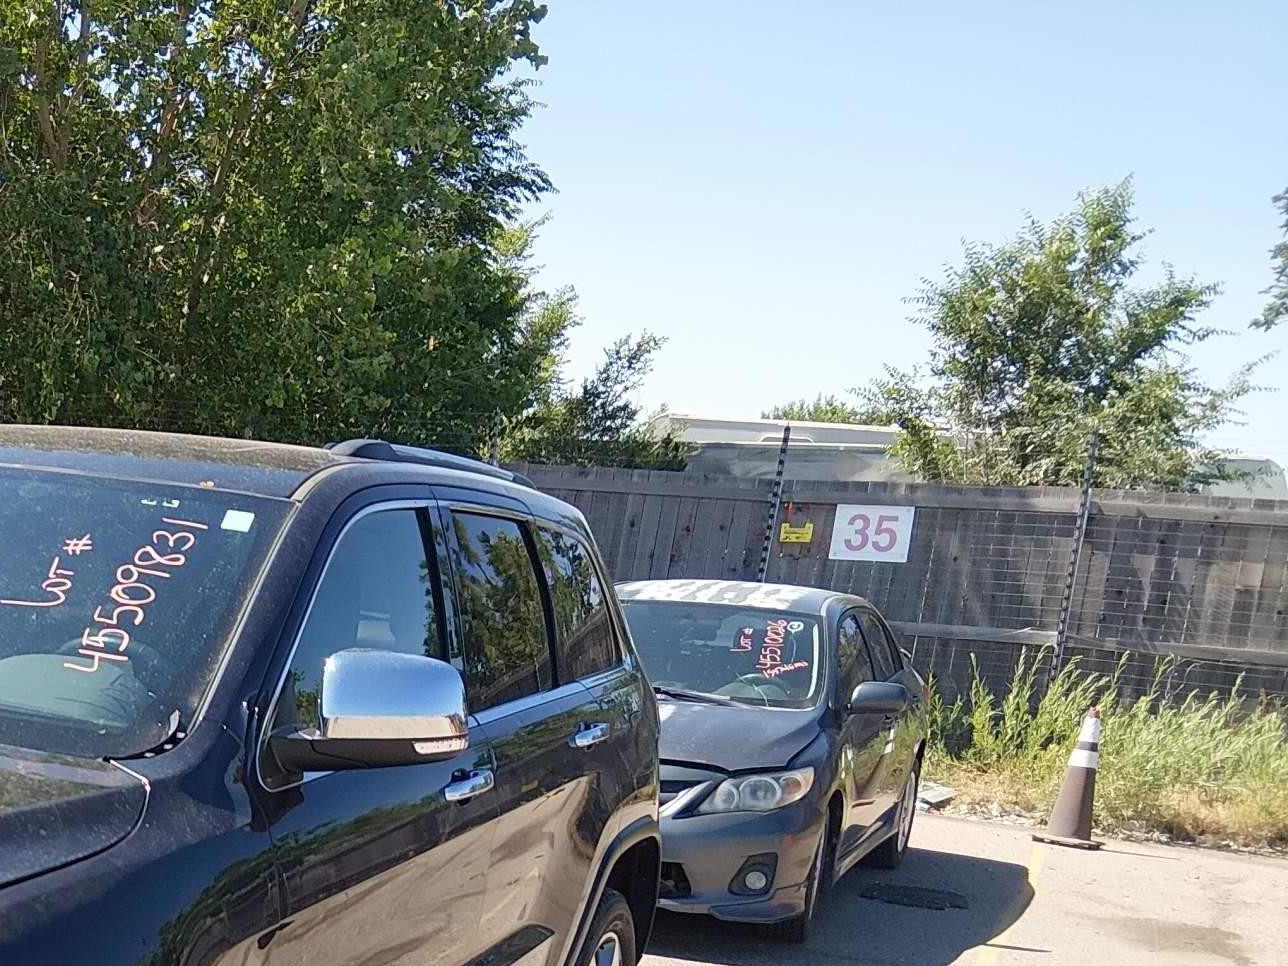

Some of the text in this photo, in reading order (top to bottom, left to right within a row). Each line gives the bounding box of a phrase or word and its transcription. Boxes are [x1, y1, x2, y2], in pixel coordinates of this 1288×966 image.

[62, 533, 93, 555] #
[843, 513, 900, 553] 35
[63, 517, 209, 673] 45509831
